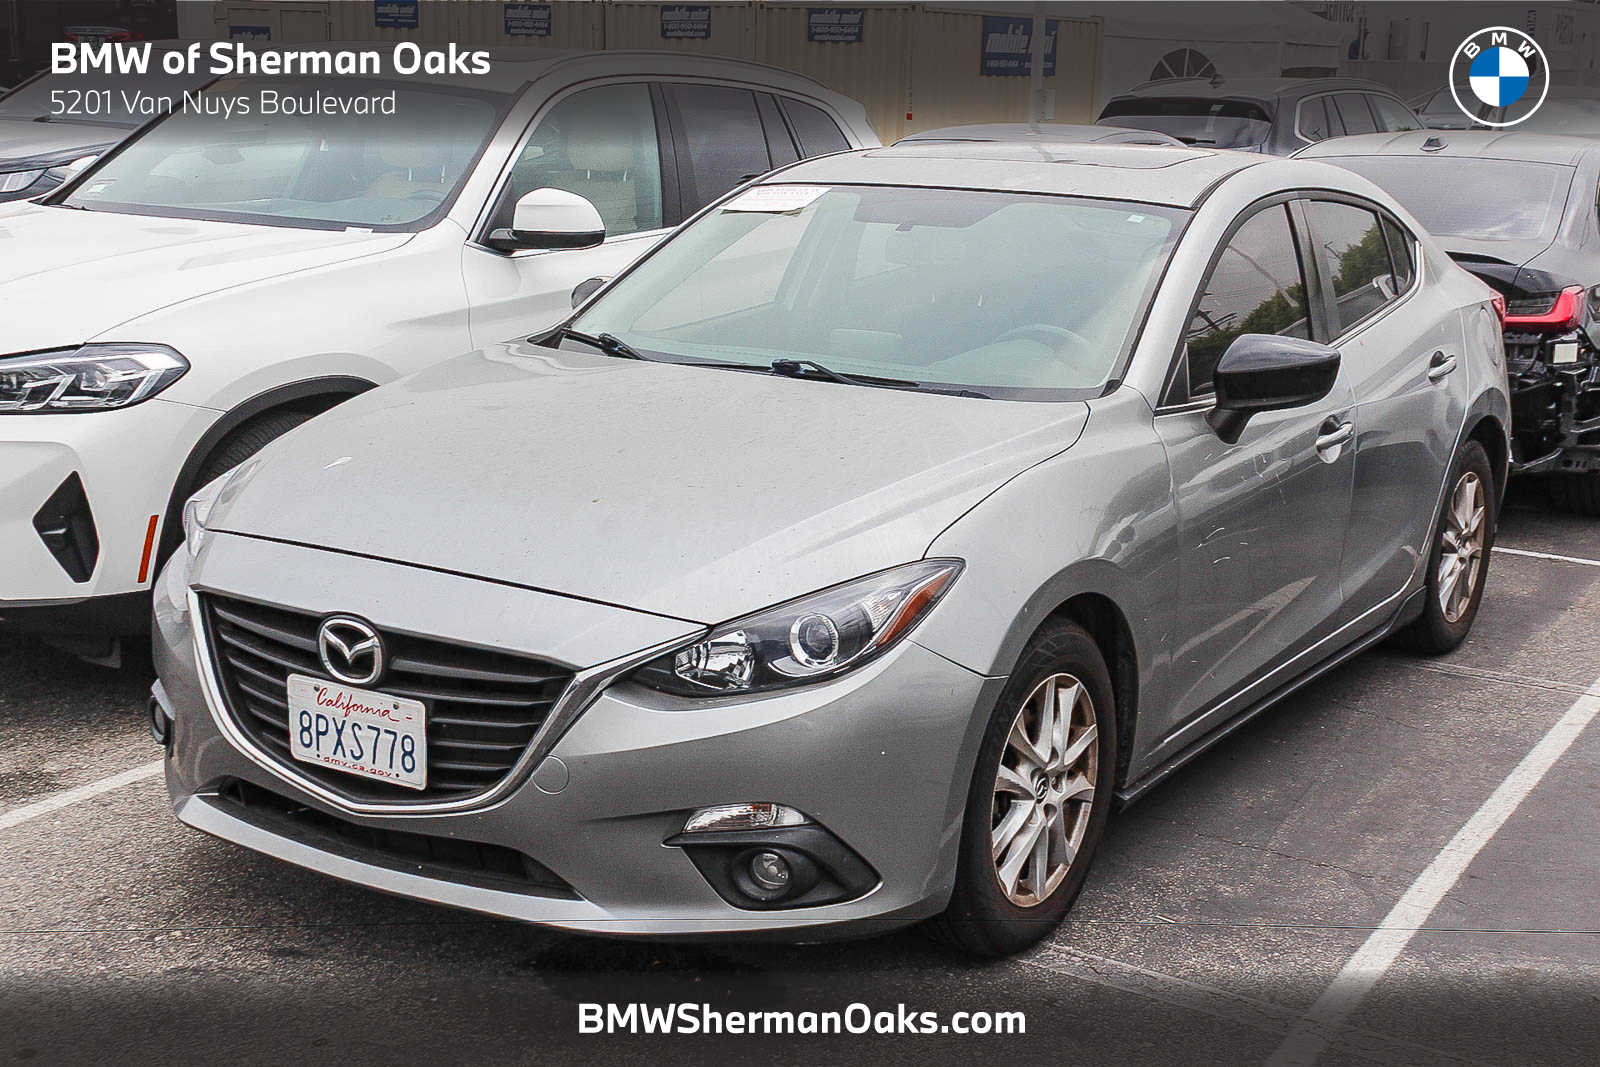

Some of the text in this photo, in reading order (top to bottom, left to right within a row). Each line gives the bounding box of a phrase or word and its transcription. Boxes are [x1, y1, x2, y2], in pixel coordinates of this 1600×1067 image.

[985, 23, 1029, 53] mobile
[316, 687, 400, 722] California
[299, 710, 416, 774] 8PXS778
[323, 756, 392, 778] dmv.ca.gov
